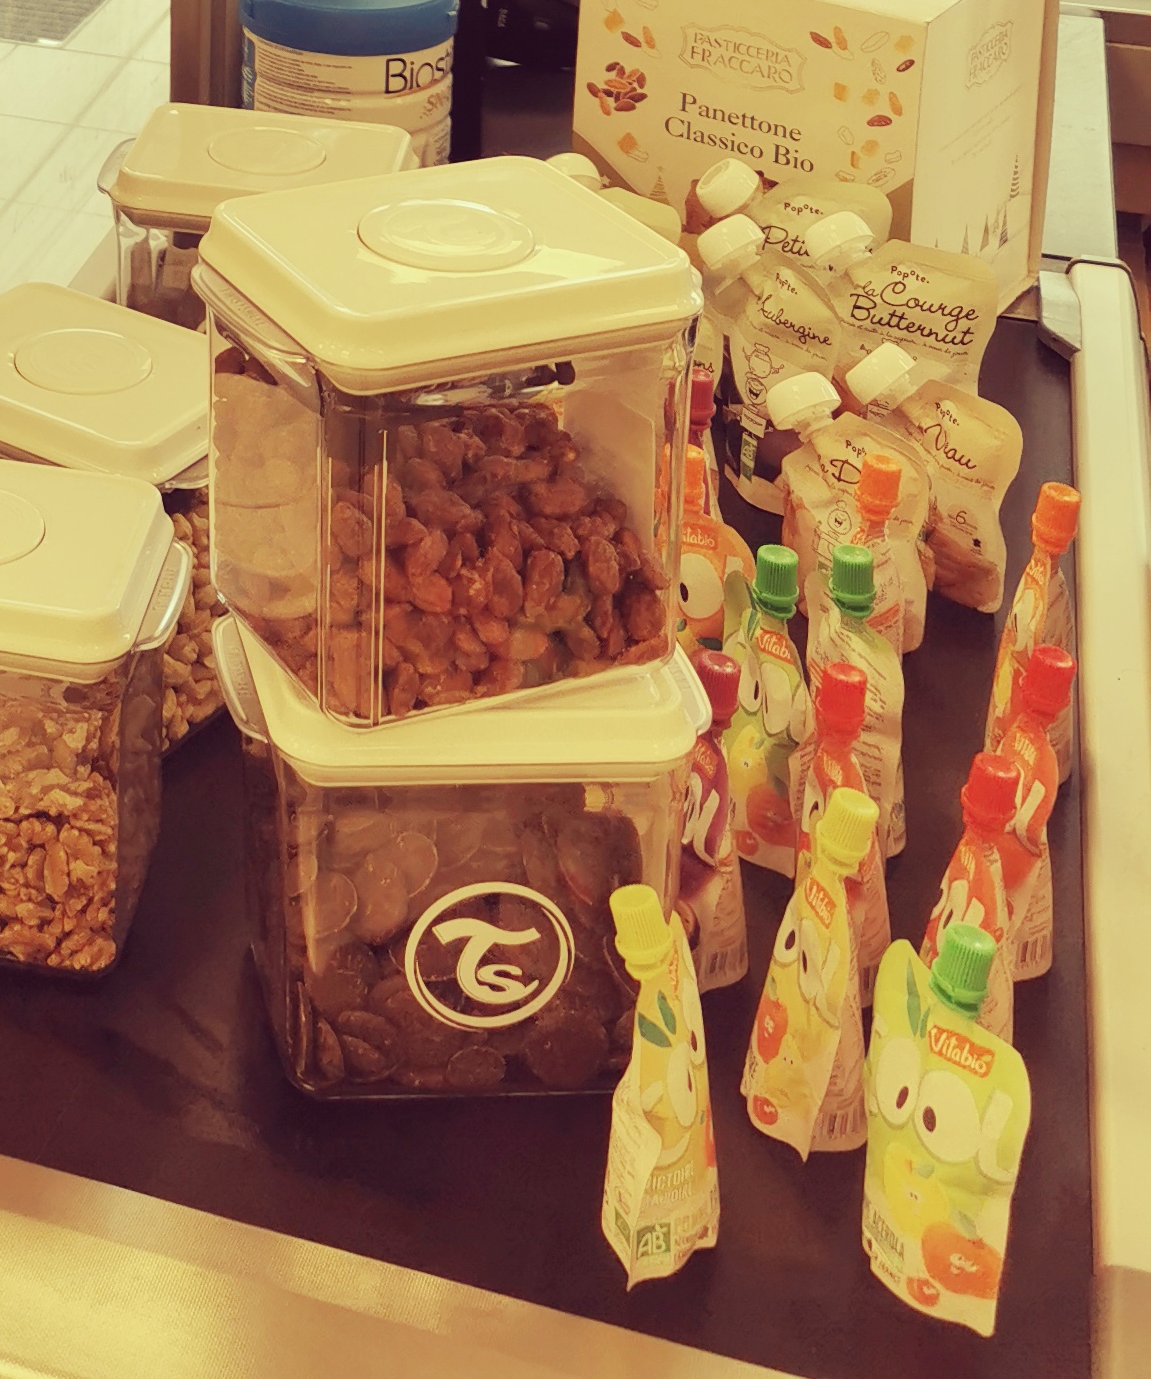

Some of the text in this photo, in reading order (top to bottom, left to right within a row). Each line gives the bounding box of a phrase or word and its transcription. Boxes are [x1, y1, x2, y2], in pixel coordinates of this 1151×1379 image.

[690, 45, 793, 84] FRACCARO
[679, 91, 802, 142] Panettone
[664, 116, 814, 172] Classico Bio
[850, 293, 975, 345] Butternut
[880, 280, 979, 332] Courge
[930, 1028, 988, 1076] Vitabio
